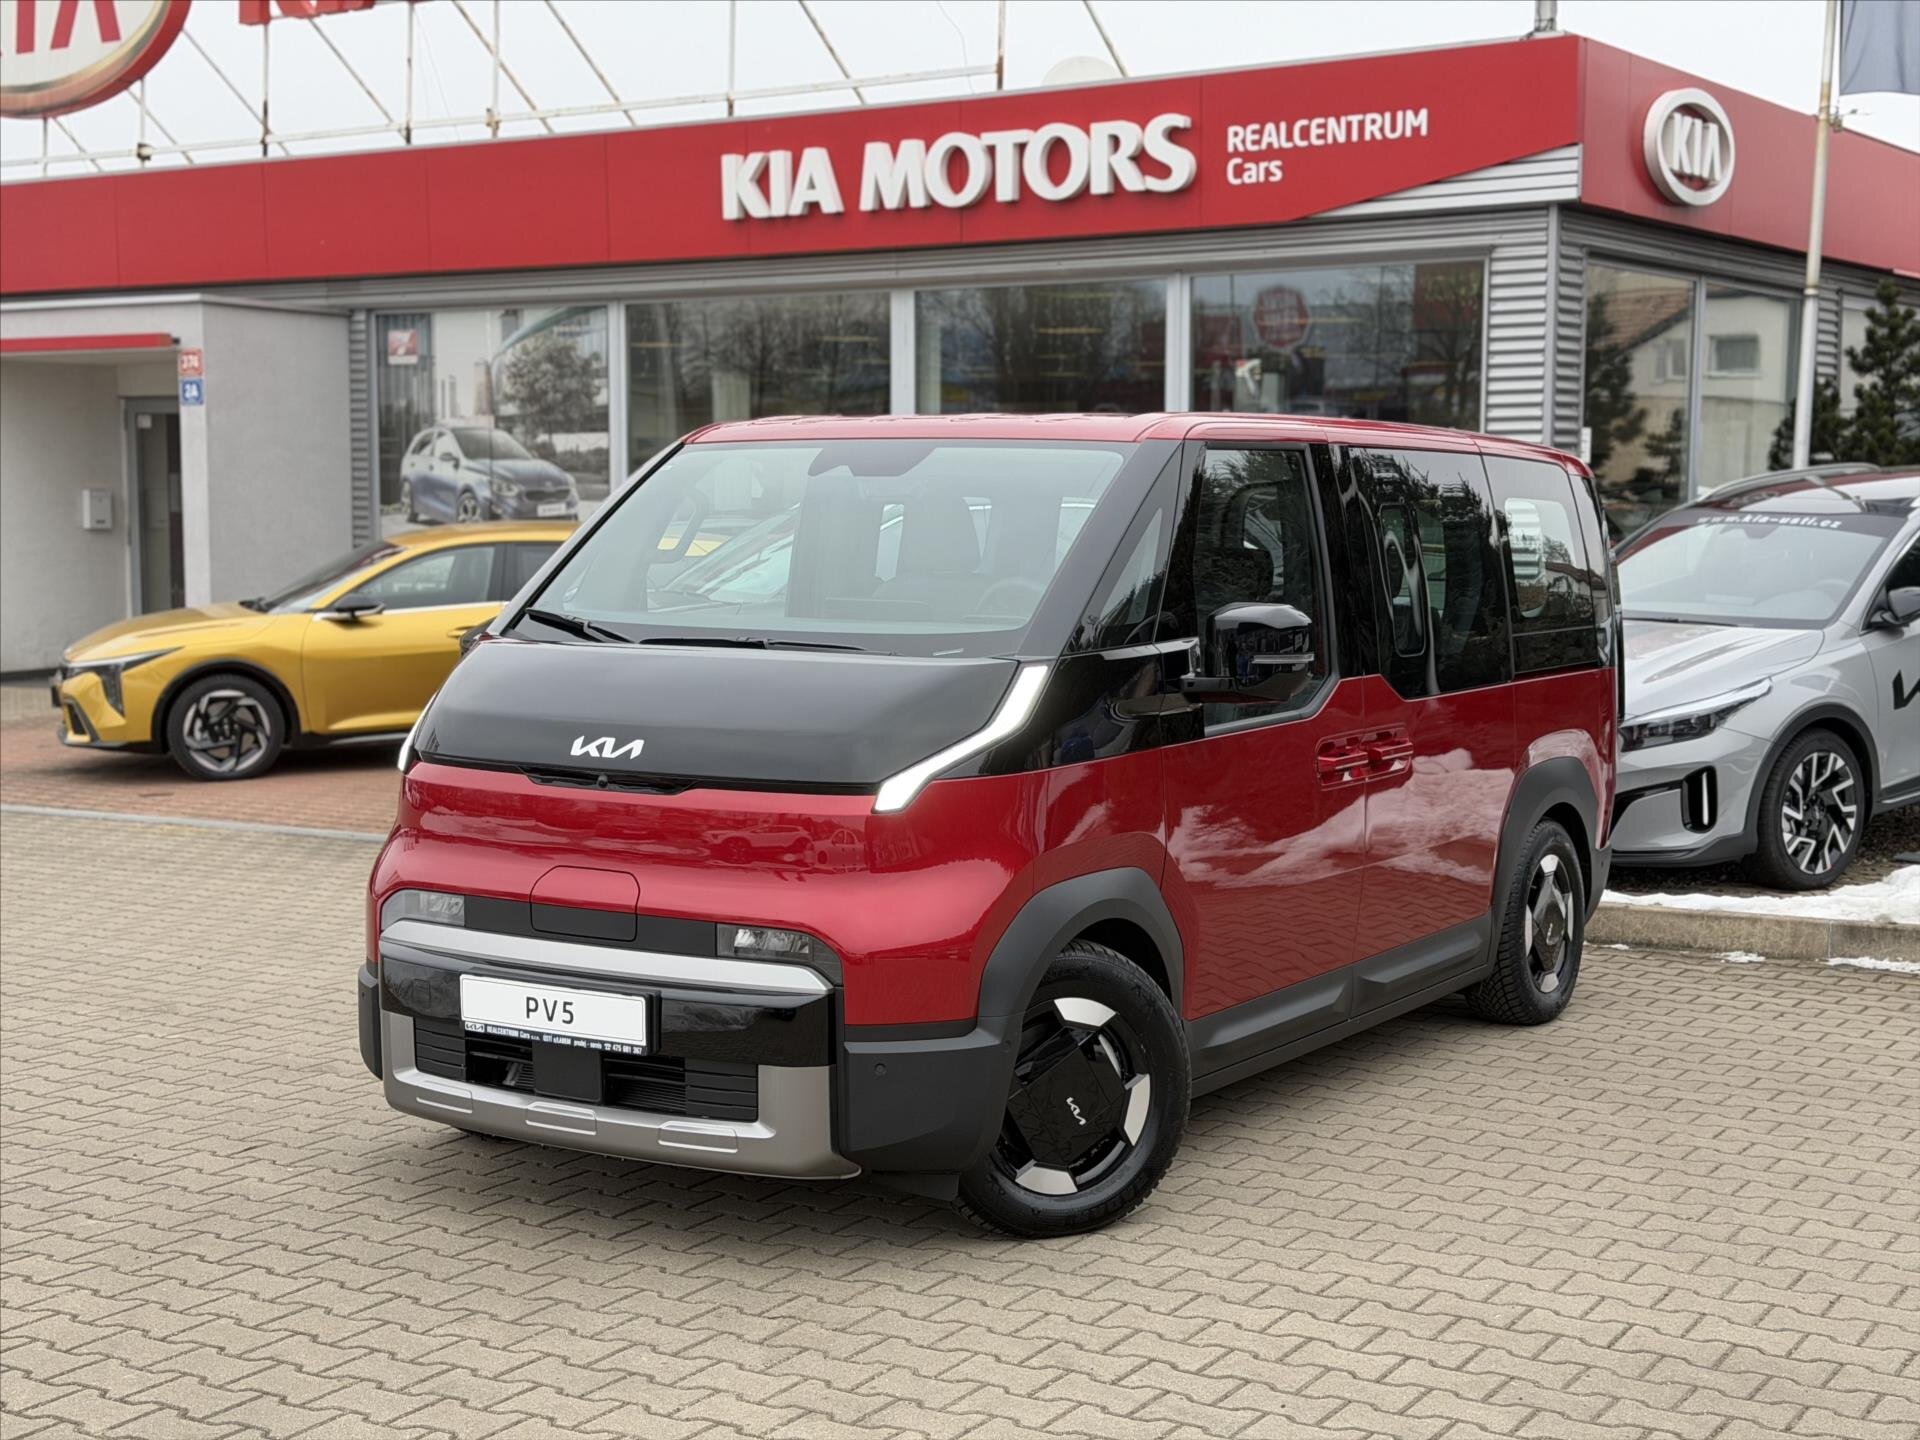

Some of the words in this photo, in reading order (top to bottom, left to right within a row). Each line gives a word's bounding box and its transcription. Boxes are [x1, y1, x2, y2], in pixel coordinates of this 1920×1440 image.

[1226, 107, 1428, 153] REALCENTRUM
[1672, 111, 1721, 181] KIA
[721, 147, 845, 221] KIA
[859, 113, 1197, 212] MOTORS
[1226, 157, 1283, 185] Cars
[525, 996, 575, 1025] PV5
